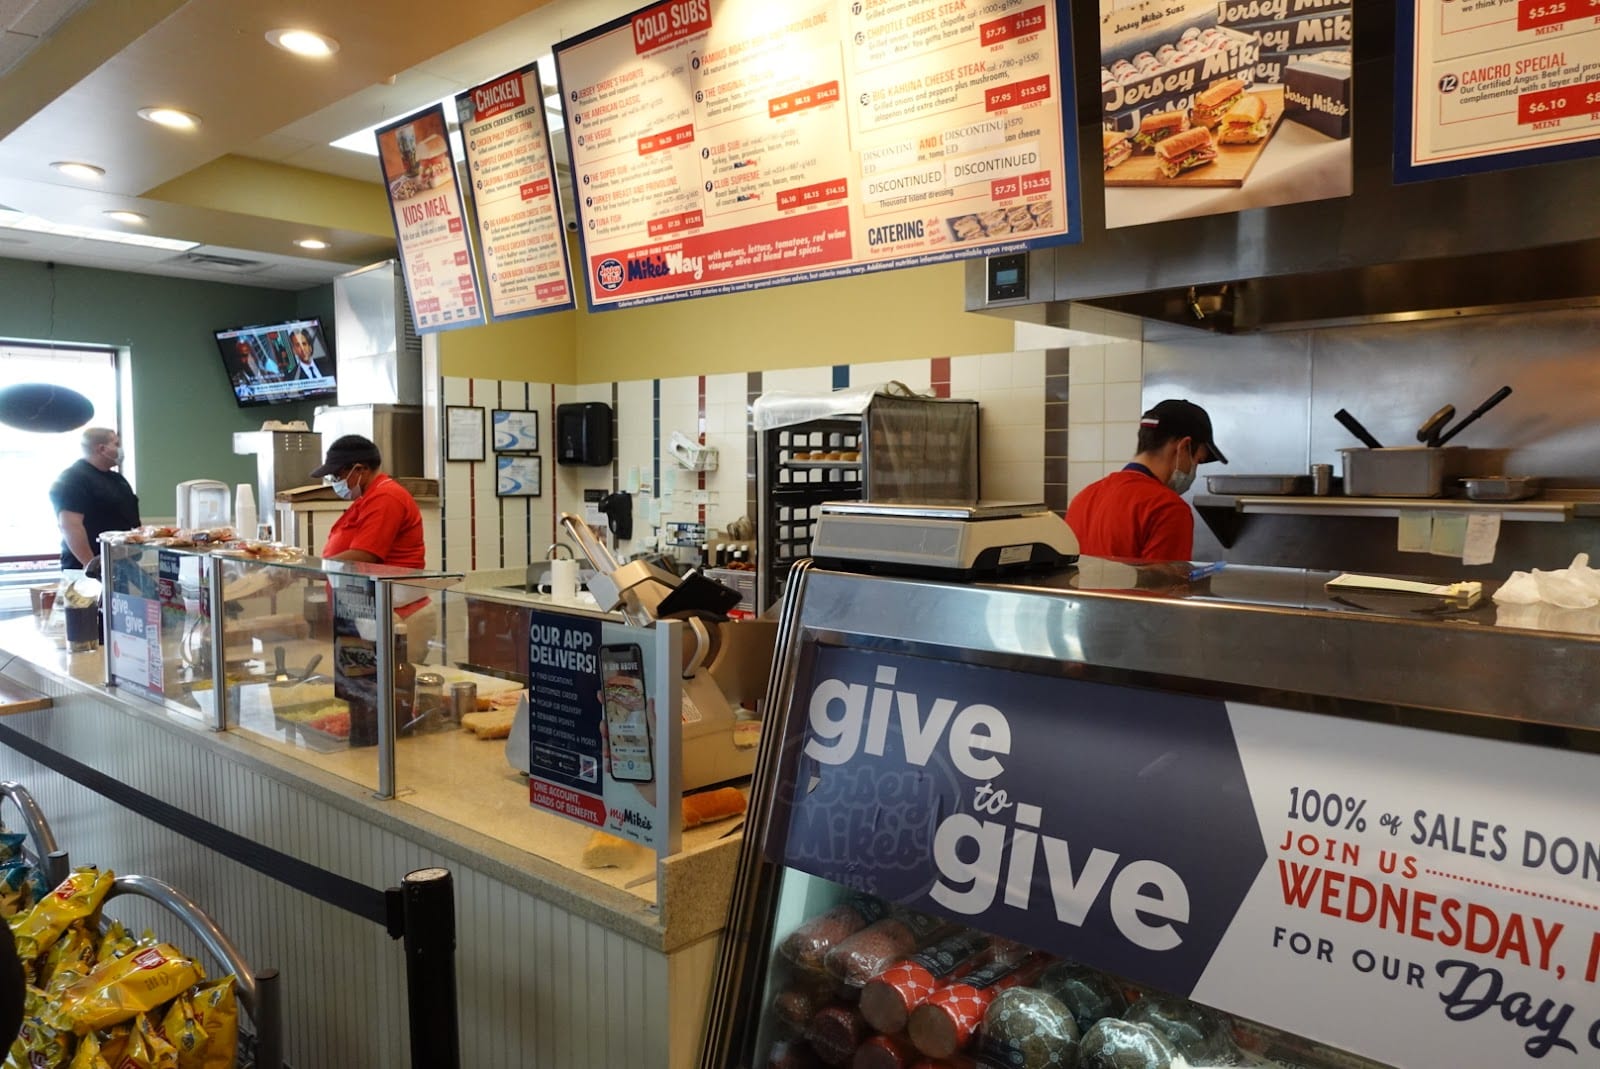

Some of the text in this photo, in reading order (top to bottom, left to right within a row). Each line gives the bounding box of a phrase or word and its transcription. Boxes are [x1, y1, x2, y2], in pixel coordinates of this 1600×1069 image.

[635, 0, 707, 45] COLD SUBS
[867, 2, 967, 39] CHIPOTLE CHEESE STEAK
[940, 13, 967, 29] chipotle
[1218, 0, 1283, 25] Jersey
[1528, 3, 1567, 20] $5.25
[985, 15, 1042, 40] $7.75 $13.35
[1114, 20, 1140, 35] Jersey
[1535, 23, 1564, 37] MINI
[990, 34, 1040, 53] REG GIANT
[1460, 85, 1475, 96] Our
[1477, 76, 1511, 93] Certified
[1513, 73, 1539, 88] Angus
[1541, 67, 1562, 80] Beef
[1563, 63, 1580, 76] and
[1461, 51, 1569, 86] CANCRO SPECIAL
[872, 87, 887, 99] BIG
[888, 78, 923, 97] KAHUNA
[925, 69, 956, 88] CHEESE
[957, 61, 987, 79] STEAK
[987, 62, 998, 73] cal:
[1105, 69, 1196, 112] Jersey
[1442, 75, 1456, 92] 12
[1459, 86, 1519, 106] complemented
[1520, 83, 1540, 95] with
[1548, 76, 1570, 91] layer
[1572, 73, 1583, 83] of
[474, 77, 521, 113] CHICKEN
[578, 86, 596, 99] JERSEY
[704, 87, 717, 98] THE
[874, 71, 1010, 112] Grilled onions and peppers plus mushrooms,
[991, 83, 1047, 105] $7.95 $13.95
[1284, 84, 1350, 117] Jersey Mike's
[581, 109, 591, 120] THE
[590, 101, 618, 117] AMERICAN
[618, 94, 641, 110] CLASSIC
[904, 94, 958, 116] and extra cheese!
[1022, 101, 1043, 111] GIANT
[1528, 98, 1567, 114] $6.10
[469, 106, 536, 137] CHICKEN CHEESE STEAKS
[944, 119, 1004, 140] DISCONTINU
[1531, 119, 1561, 131] MINI
[584, 134, 595, 144] THE
[595, 127, 612, 141] VEGGIE
[919, 136, 938, 150] AND
[1019, 129, 1041, 144] cheese
[711, 143, 726, 156] CLUB
[727, 140, 741, 152] SUB
[946, 144, 959, 155] ED
[590, 173, 599, 183] THE
[599, 167, 616, 180] SUPER
[865, 164, 877, 174] ED
[953, 152, 1038, 178] DISCONTINUED
[714, 170, 760, 189] CLUB SUPREME
[869, 170, 942, 195] DISCONTINUED
[994, 177, 1051, 196] $7.75 $13.35
[592, 193, 612, 206] TURKEY
[612, 187, 632, 201] BREAST
[780, 195, 796, 205] $6.10
[879, 187, 955, 209] Thousand Island dressing
[1026, 194, 1048, 203] GIANT
[402, 195, 453, 228] KIDS MEAL
[595, 214, 622, 228] TUNA FISH
[867, 219, 924, 247] CATERING
[707, 229, 846, 260] with onions, lettuce, tomatoes, red wine
[882, 245, 895, 255] any
[897, 240, 925, 250] occasion
[708, 245, 823, 272] vinegar, olive oil blend and spices.
[111, 595, 130, 616] give
[125, 613, 144, 632] give
[530, 623, 593, 650] OUR APP
[530, 646, 597, 675] DELIVERS!
[803, 664, 1012, 780] give
[534, 782, 581, 803] ONE ACCOUNT.
[973, 780, 1013, 815] to
[533, 793, 600, 823] LOADS OF BENEFITS.
[1287, 786, 1368, 833] 100%
[1380, 813, 1403, 836] of
[1409, 809, 1508, 862] SALES
[1280, 830, 1419, 880] JOIN US
[929, 803, 1191, 952] give
[1277, 858, 1567, 981] WEDNESDAY,
[1272, 926, 1427, 989] FOR OUR
[1435, 958, 1579, 1059] Day
